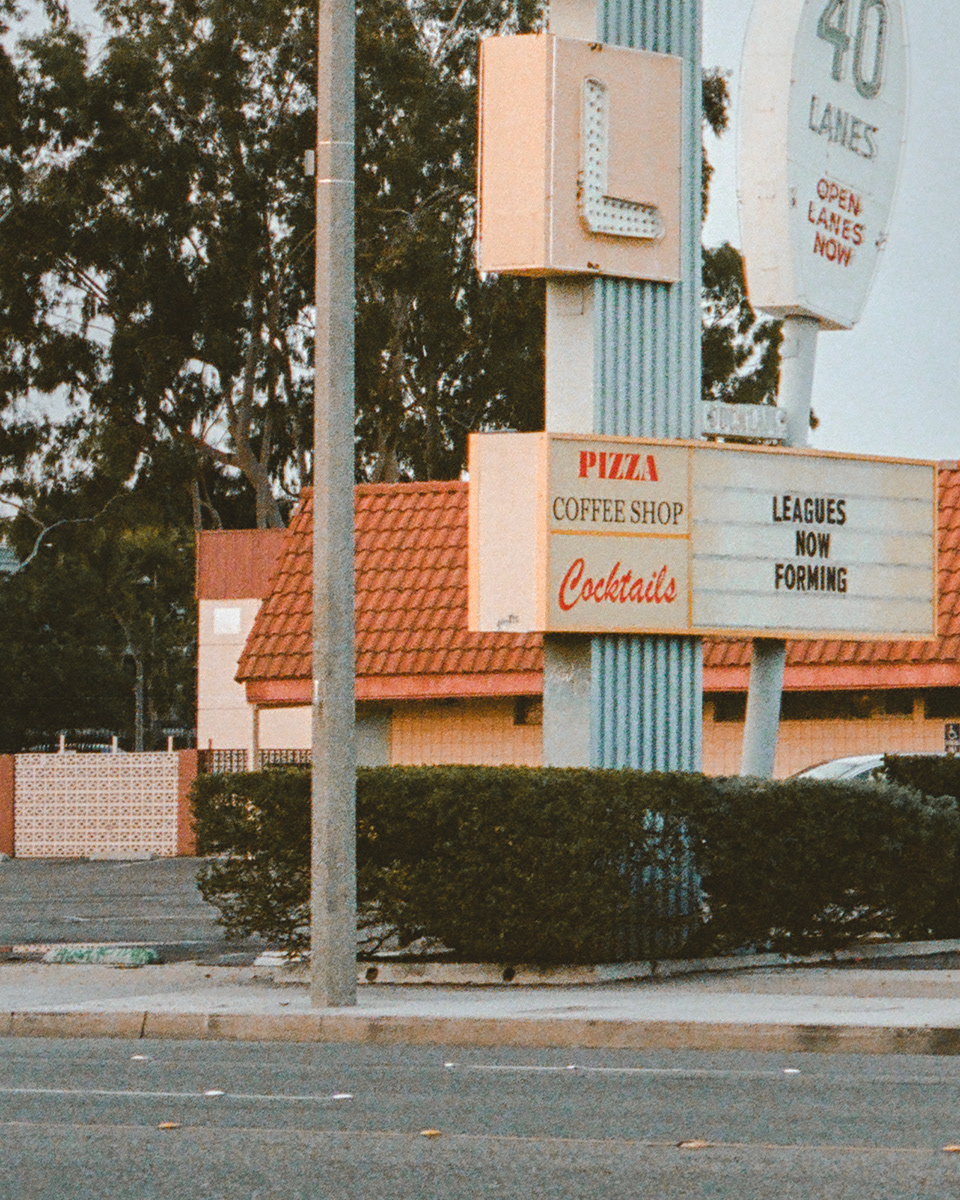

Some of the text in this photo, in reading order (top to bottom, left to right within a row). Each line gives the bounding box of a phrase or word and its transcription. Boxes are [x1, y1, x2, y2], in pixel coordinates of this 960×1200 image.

[808, 95, 879, 159] LANES
[817, 178, 862, 217] OPEN
[807, 201, 864, 246] LANES
[813, 231, 852, 267] NOW
[578, 450, 660, 483] PIZZA
[552, 496, 684, 527] COFFEE SHOP
[771, 495, 847, 526] LEAGUES
[795, 530, 831, 559] NOW
[558, 557, 678, 612] Cocktails
[774, 563, 848, 594] FORMING
